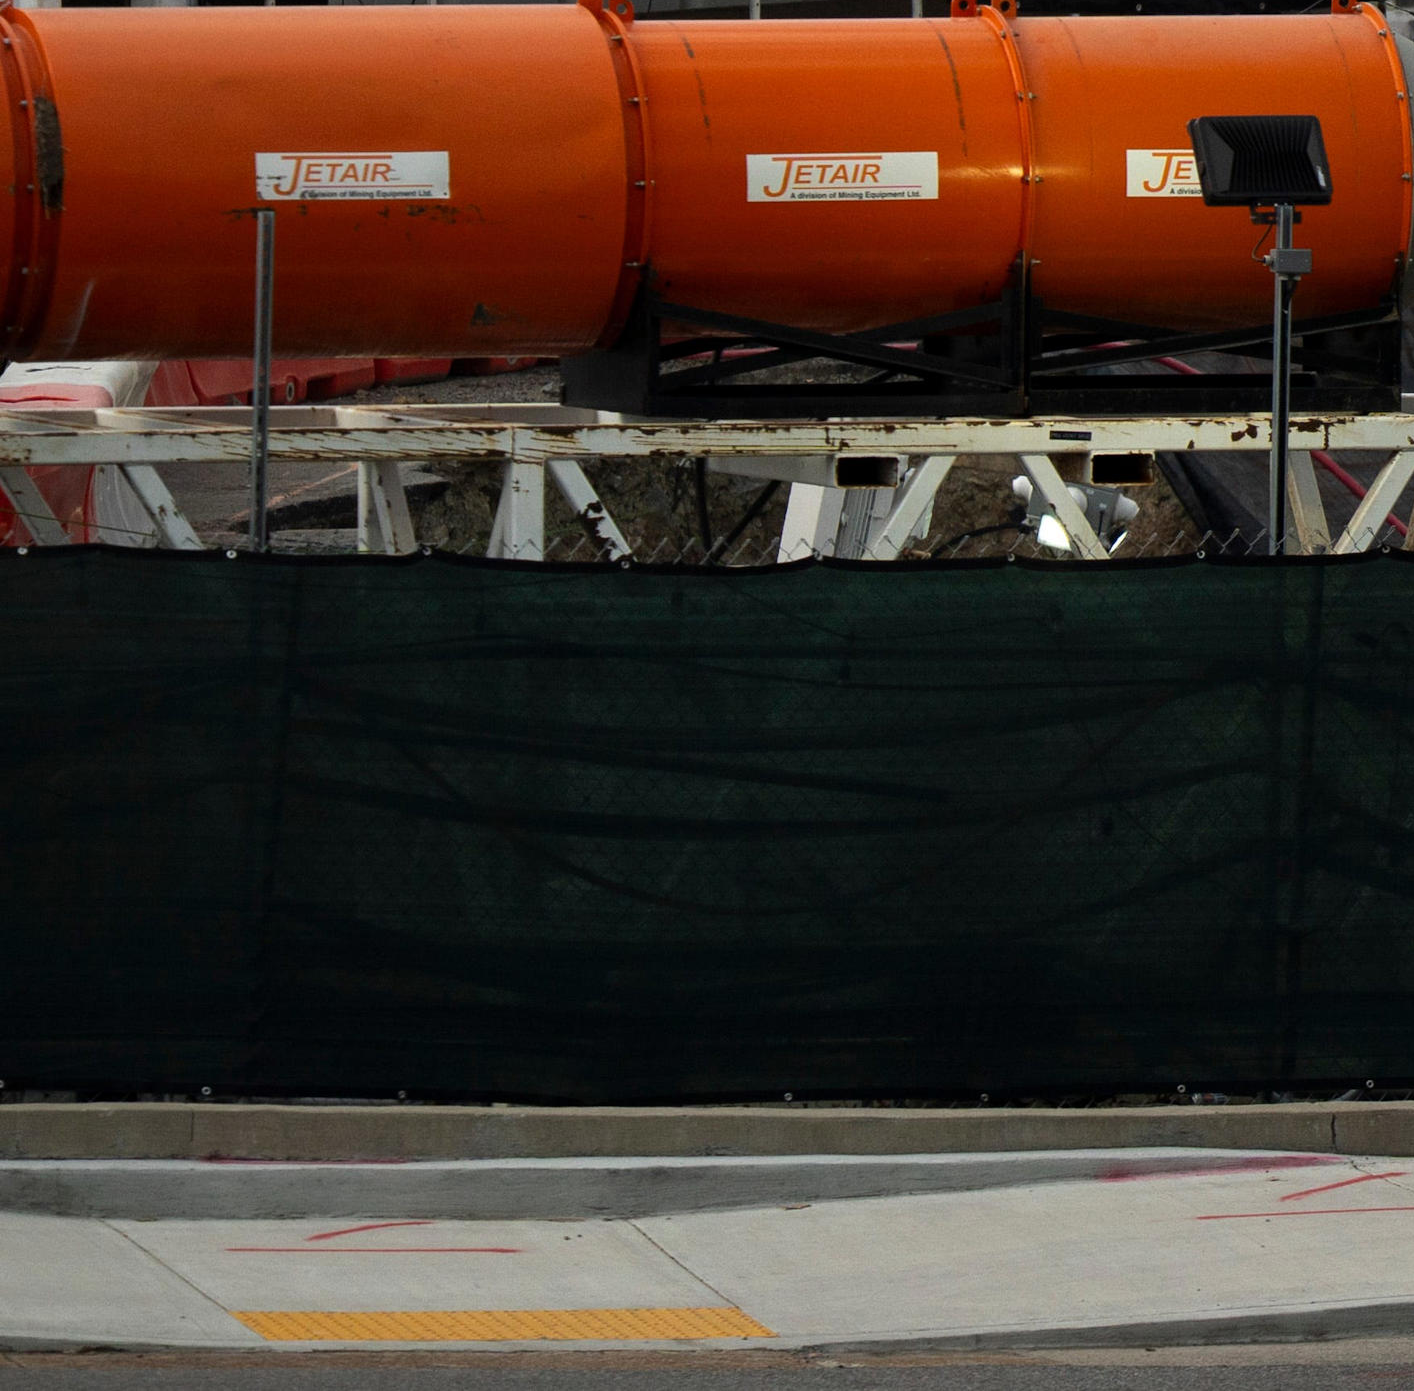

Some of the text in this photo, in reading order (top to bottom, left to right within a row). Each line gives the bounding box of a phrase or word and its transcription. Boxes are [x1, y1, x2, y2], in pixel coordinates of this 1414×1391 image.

[273, 156, 393, 196] JETAIR
[763, 156, 883, 198] JETAIR
[339, 190, 347, 198] of
[348, 190, 375, 199] Mining
[376, 189, 417, 199] Equipment
[418, 189, 433, 197] Ltd.
[797, 191, 828, 199] division
[838, 191, 864, 200] Mining
[864, 190, 906, 200] Equipment
[907, 190, 922, 198] Ltd.
[1177, 187, 1203, 195] divisio
